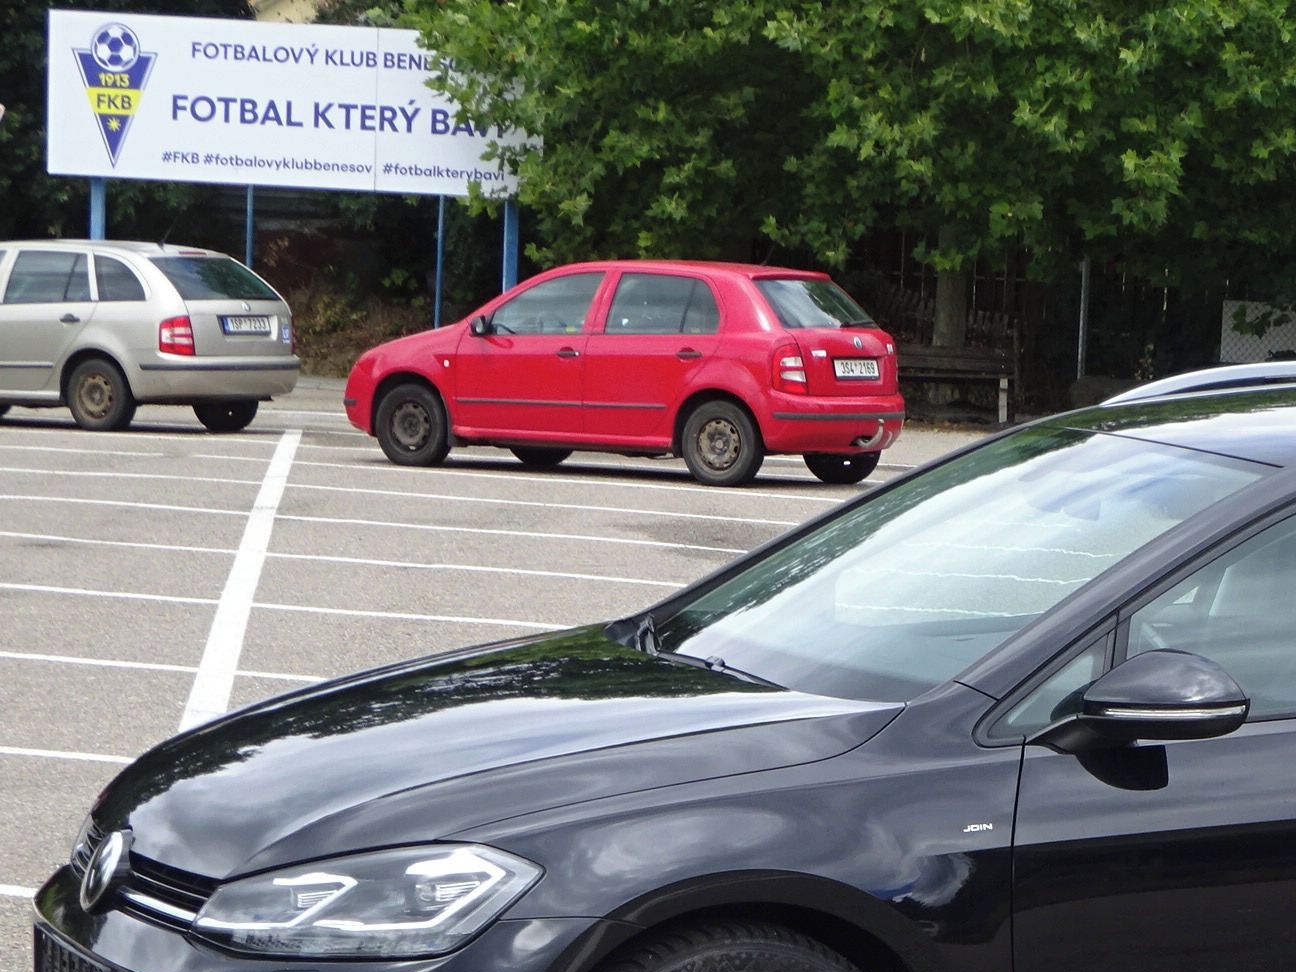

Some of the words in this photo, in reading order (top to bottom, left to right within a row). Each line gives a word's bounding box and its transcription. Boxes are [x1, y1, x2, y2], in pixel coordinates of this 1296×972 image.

[191, 41, 319, 65] FOTBALOVÝ
[324, 49, 377, 68] KLUB
[98, 72, 130, 88] 1913
[96, 93, 132, 110] FKB
[172, 94, 303, 127] FOTBAL
[313, 99, 421, 133] KTERÝ
[161, 151, 200, 165] #FKB
[203, 153, 373, 174] #fotbalovyklubbenesov
[962, 822, 993, 833] JOIN
